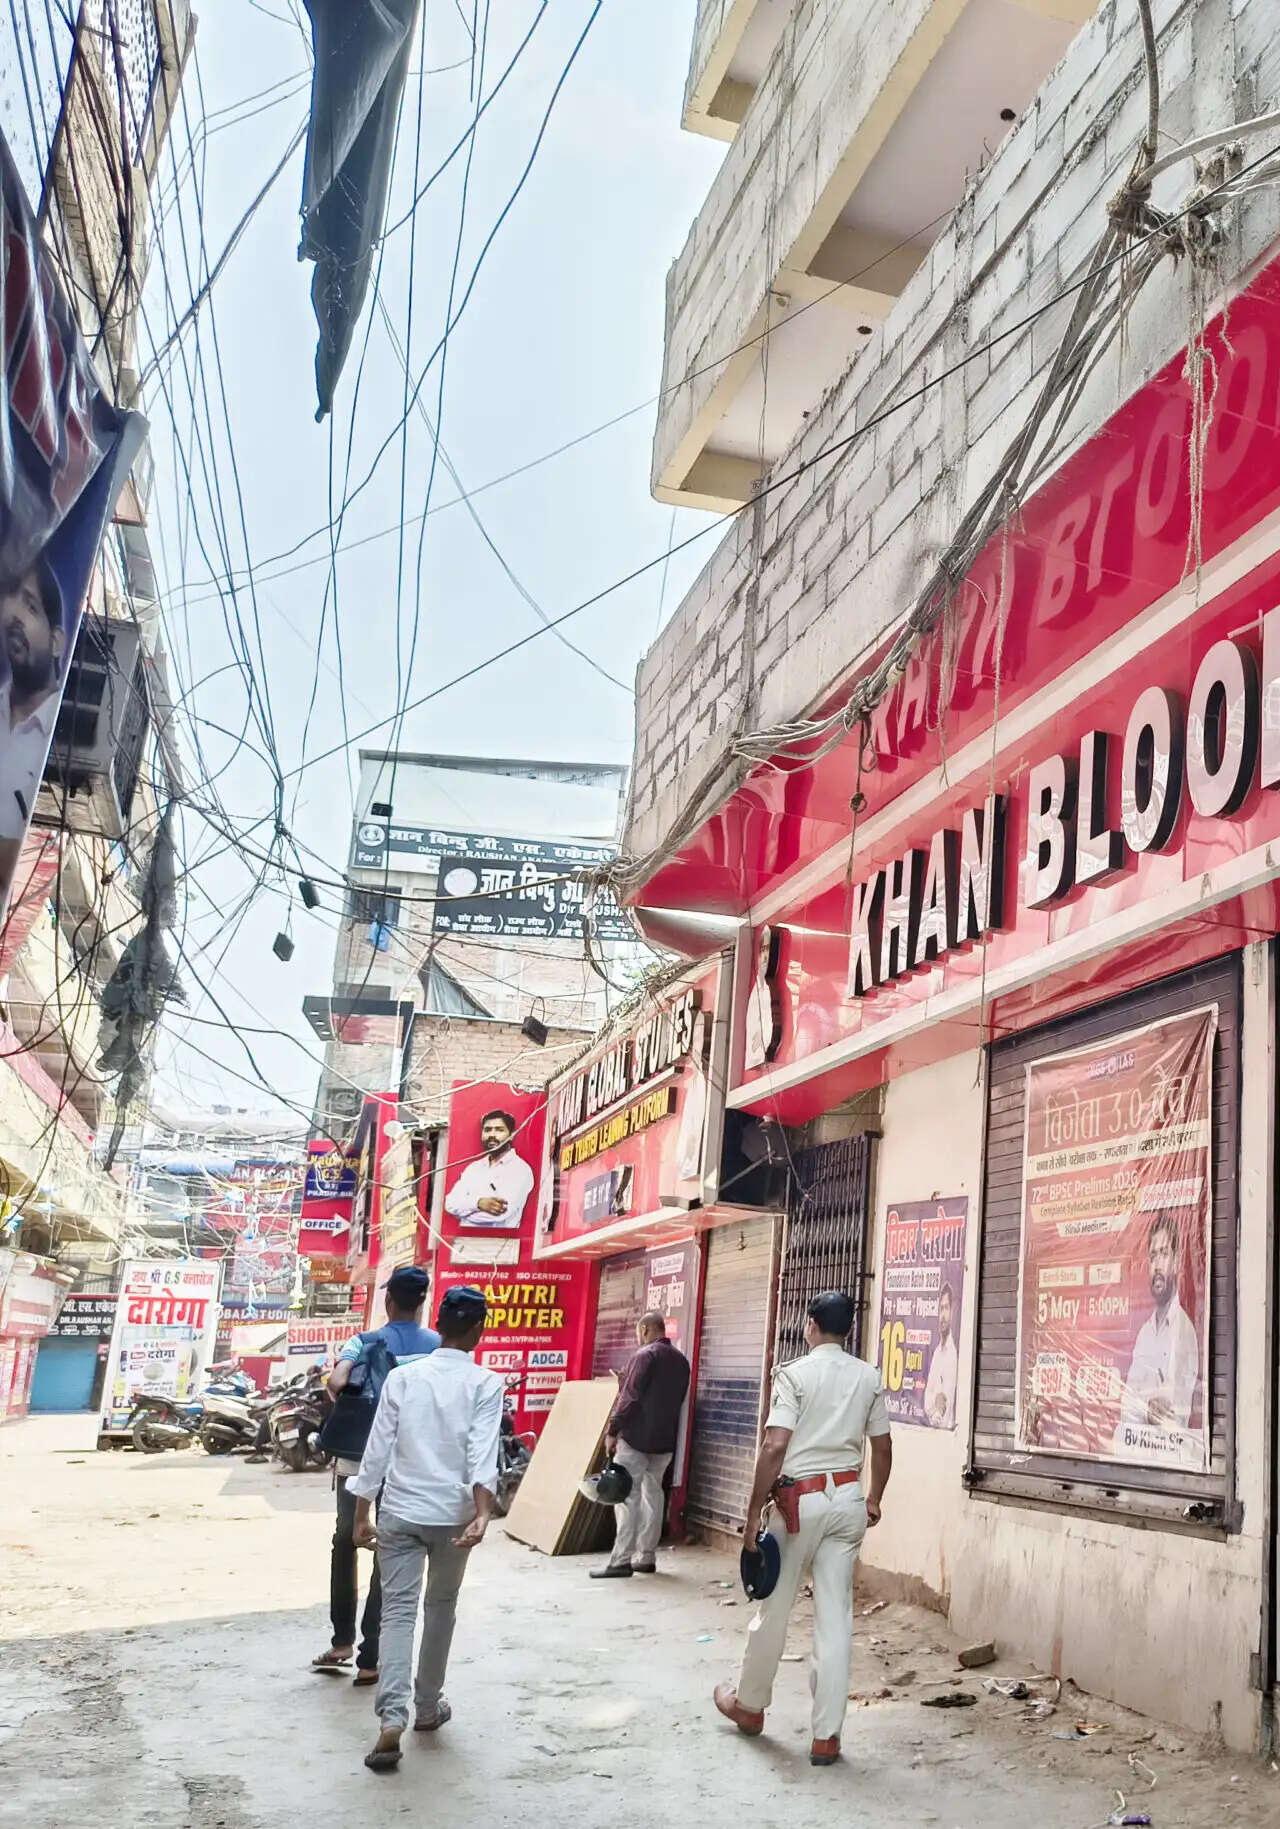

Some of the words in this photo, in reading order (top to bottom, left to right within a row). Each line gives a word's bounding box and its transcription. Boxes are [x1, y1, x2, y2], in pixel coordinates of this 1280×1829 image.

[848, 793, 1006, 998] KHAN
[633, 989, 694, 1085] STUIES
[1044, 1088, 1101, 1148] विजेता
[1108, 1088, 1142, 1134] 3.0
[305, 1221, 342, 1229] OFFICE
[921, 1206, 965, 1263] दारोगा
[128, 1288, 209, 1328] दारोगा
[471, 1284, 557, 1304] AVITRI
[1051, 1296, 1081, 1327] May
[489, 1354, 518, 1366] DTP
[531, 1353, 564, 1365] ADCA
[881, 1321, 905, 1392] 16
